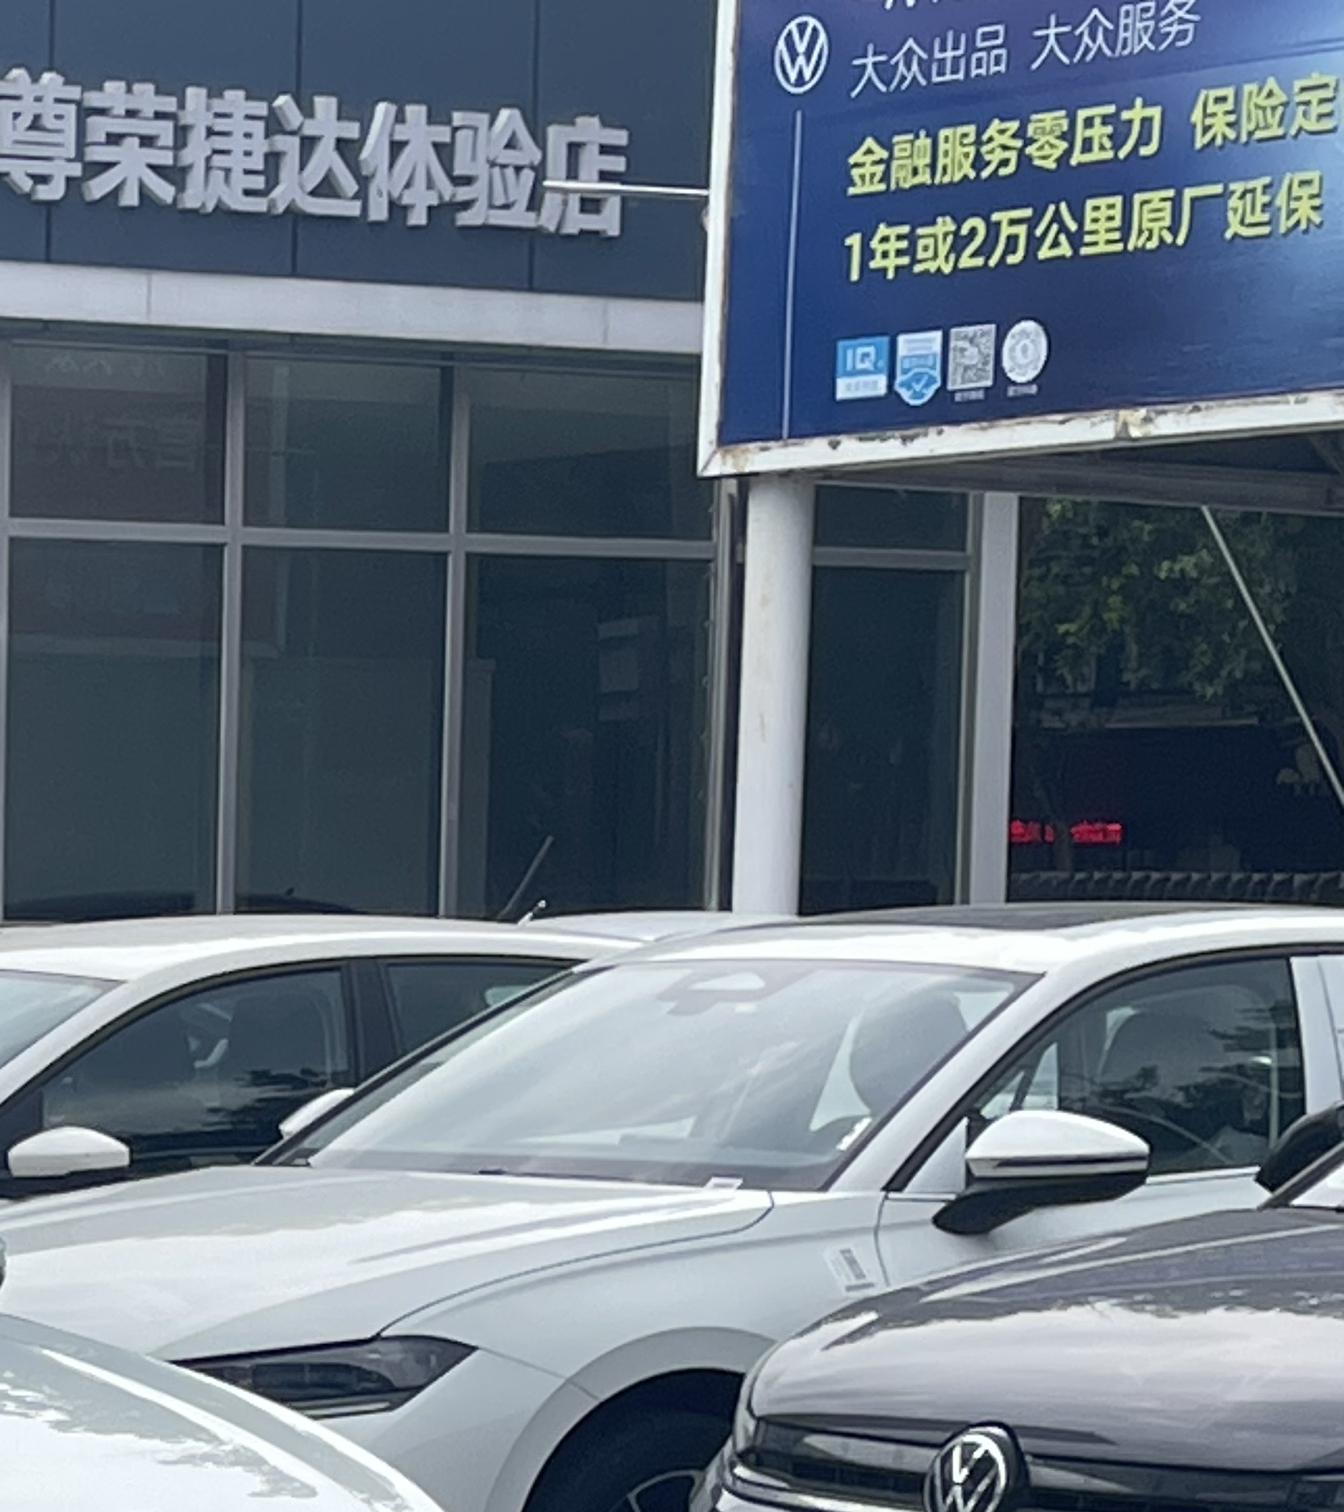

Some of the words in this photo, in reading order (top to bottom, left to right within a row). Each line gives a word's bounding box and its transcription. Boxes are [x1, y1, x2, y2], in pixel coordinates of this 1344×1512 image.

[849, 23, 1008, 99] 大众出品
[1030, 0, 1202, 71] 大众服务
[846, 97, 1163, 198] 金融服务零压力
[1189, 72, 1339, 151] 保险定
[843, 169, 1324, 282] 1年或2万公里原厂延保
